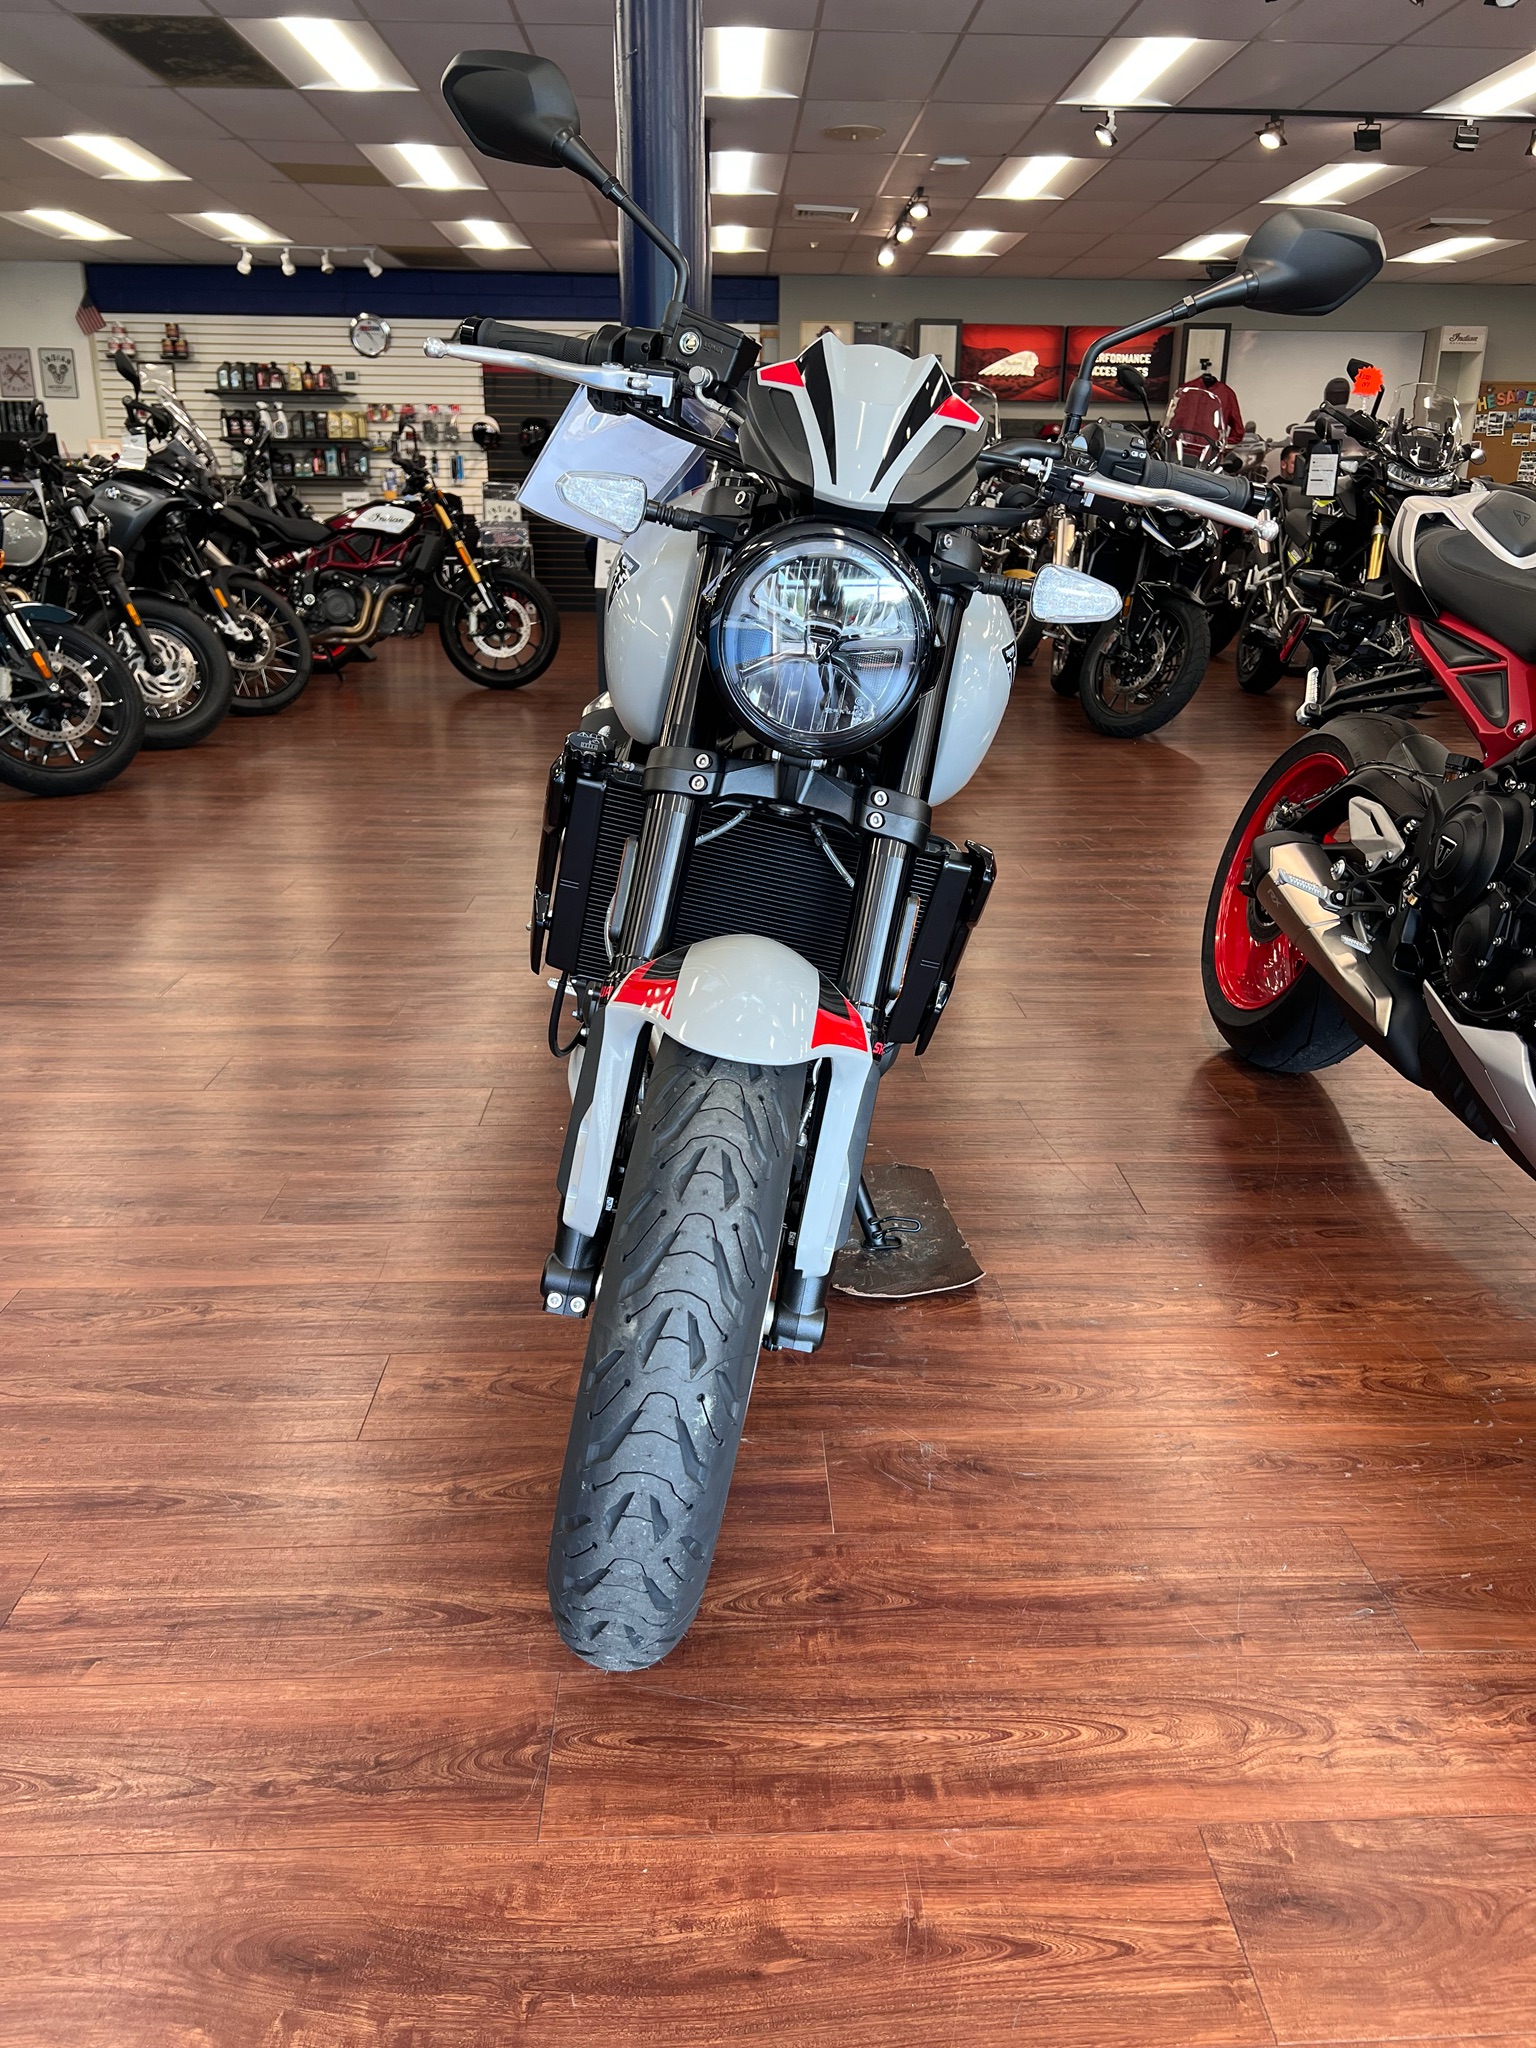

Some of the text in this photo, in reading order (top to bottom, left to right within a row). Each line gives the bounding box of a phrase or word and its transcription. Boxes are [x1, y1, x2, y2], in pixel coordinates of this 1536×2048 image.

[1449, 333, 1478, 342] Indian
[1095, 353, 1151, 364] ERFORMANCE
[487, 504, 518, 517] INDIAN
[368, 512, 405, 524] Indian
[1267, 888, 1282, 908] RX
